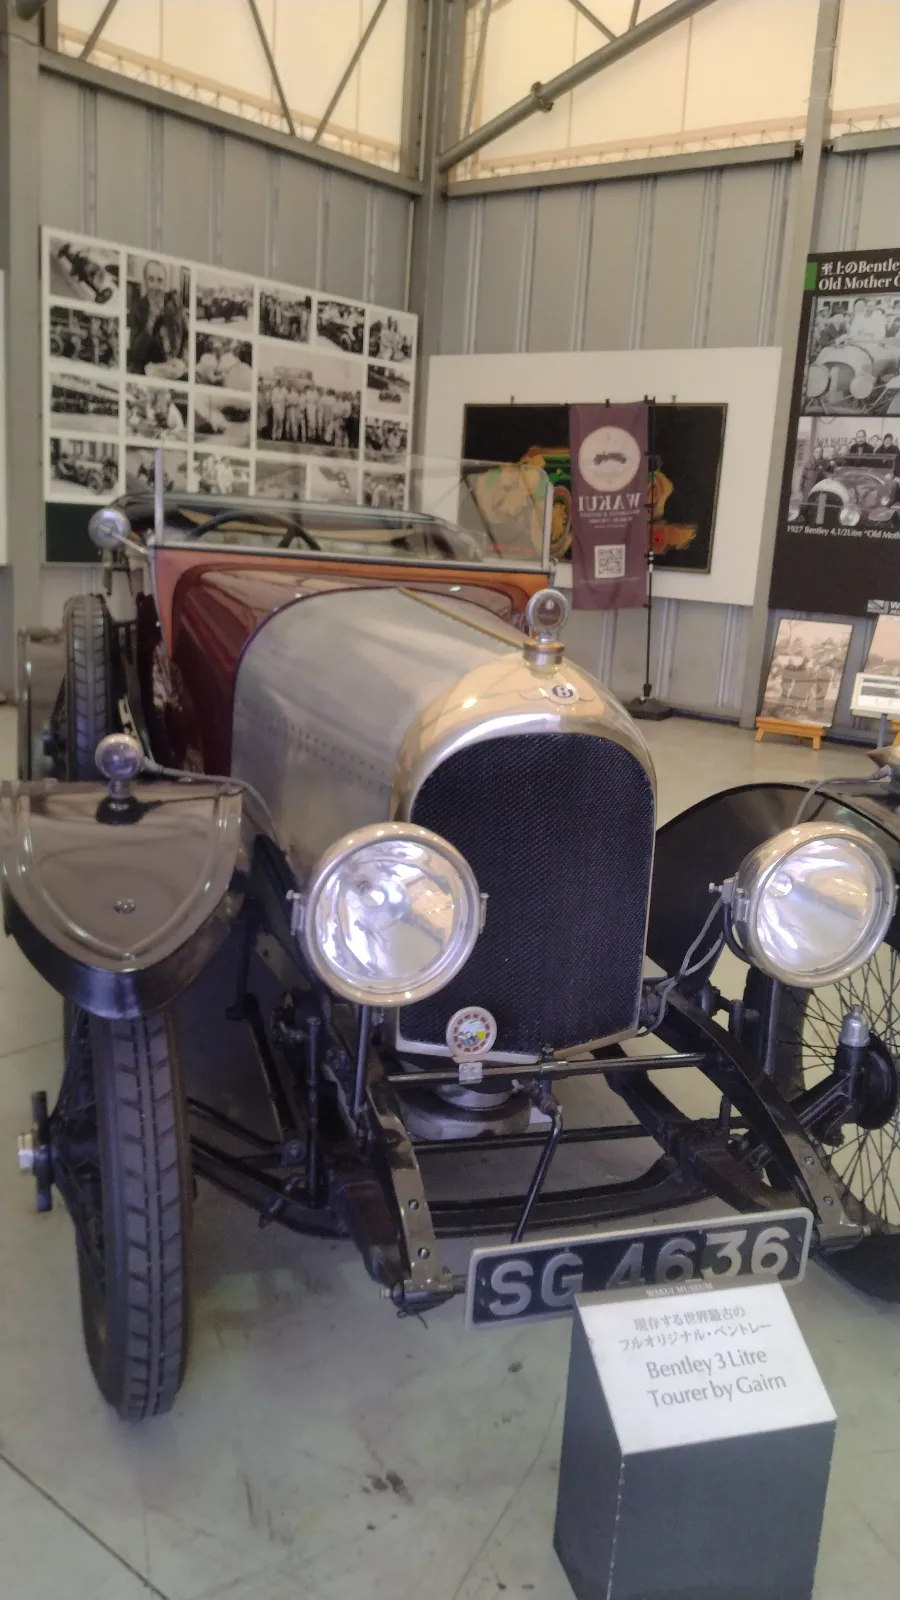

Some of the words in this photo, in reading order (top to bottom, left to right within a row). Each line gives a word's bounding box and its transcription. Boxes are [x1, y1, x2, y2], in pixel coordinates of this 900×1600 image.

[819, 276, 842, 290] Old
[844, 274, 892, 290] Mother
[787, 525, 804, 533] 1927
[489, 1252, 585, 1316] SG
[606, 1227, 791, 1289] 4636
[646, 1355, 712, 1379] Bentley
[715, 1352, 726, 1369] 3
[727, 1349, 768, 1368] Litre
[646, 1386, 708, 1408] Tourer
[709, 1380, 733, 1403] by
[736, 1374, 787, 1395] Gairn
